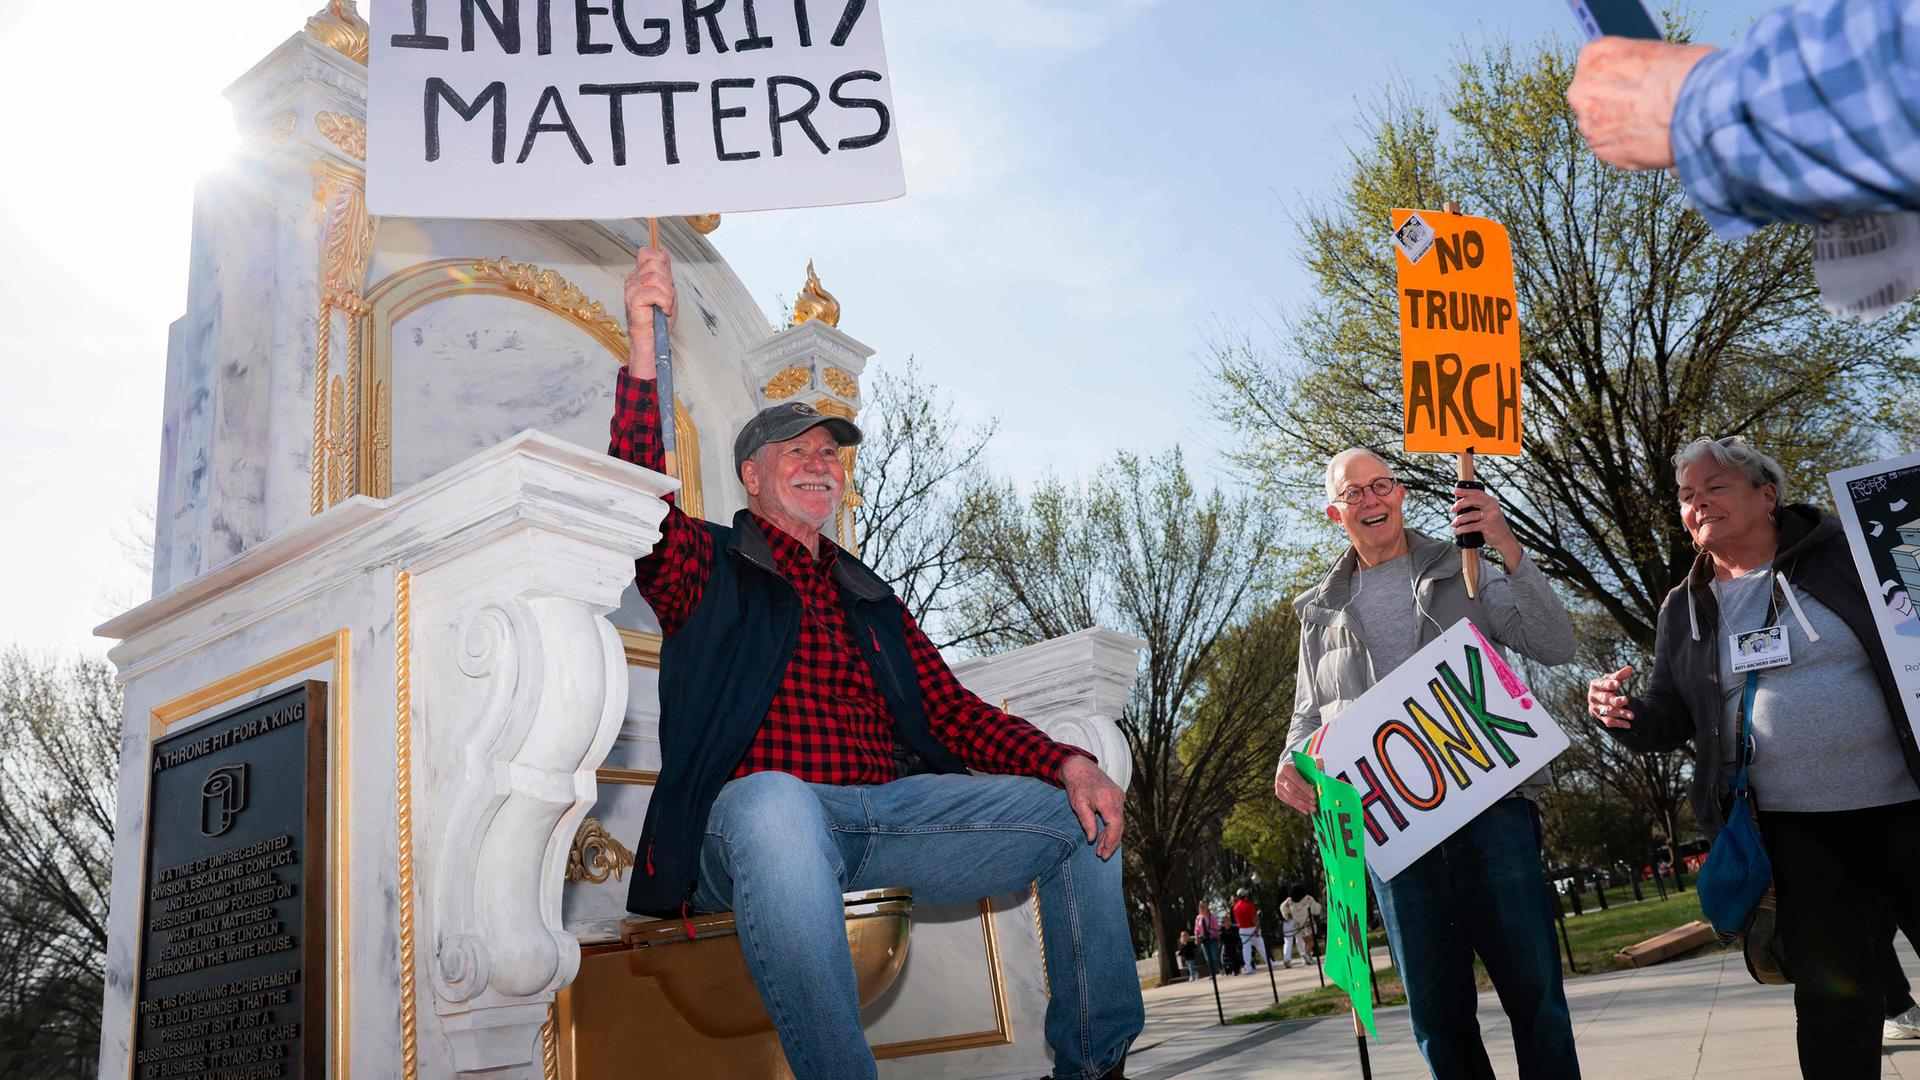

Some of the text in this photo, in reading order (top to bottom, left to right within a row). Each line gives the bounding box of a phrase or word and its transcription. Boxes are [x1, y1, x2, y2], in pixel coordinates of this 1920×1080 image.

[424, 70, 890, 166] MATTERS
[1435, 230, 1485, 275] NO
[1404, 288, 1512, 335] TRUMP
[1406, 353, 1519, 443] ARCH
[153, 703, 303, 772] A THRONE FIT FOR A KING
[151, 850, 293, 900] DIVISION, ESCALATING CONFLICT,
[156, 871, 165, 884] IN
[174, 863, 194, 878] TIME
[196, 861, 208, 872] OF
[209, 835, 288, 868] UNPRECEDENTED
[151, 884, 292, 931] PRESIDENT TRUMP FOCUSED ON
[166, 874, 277, 912] AND ECONOMIC TURMOIL,
[160, 921, 279, 961] REMODELING THE LINCOLN
[166, 908, 273, 943] WHAT TRULY MATTERED:
[146, 935, 293, 980] BATHROOM IN THE WHITE HOUSE.
[140, 970, 298, 1014] THIS, HIS CROWNING ACHIEVEMENT
[149, 1014, 157, 1028] IS
[166, 1008, 190, 1025] BOLD
[192, 998, 239, 1021] REMINDER
[242, 993, 265, 1010] THAT
[268, 989, 286, 1004] THE
[160, 1022, 210, 1042] PRESIDENT
[236, 1013, 261, 1028] JUST
[262, 1011, 270, 1024] A
[209, 1035, 231, 1050] HE'S
[232, 1027, 267, 1046] TAKING
[268, 1024, 297, 1040] CARE
[147, 1065, 160, 1078] OF
[211, 1054, 221, 1067] IT
[222, 1047, 259, 1066] STANDS
[261, 1047, 274, 1060] AS
[275, 1045, 283, 1058] A
